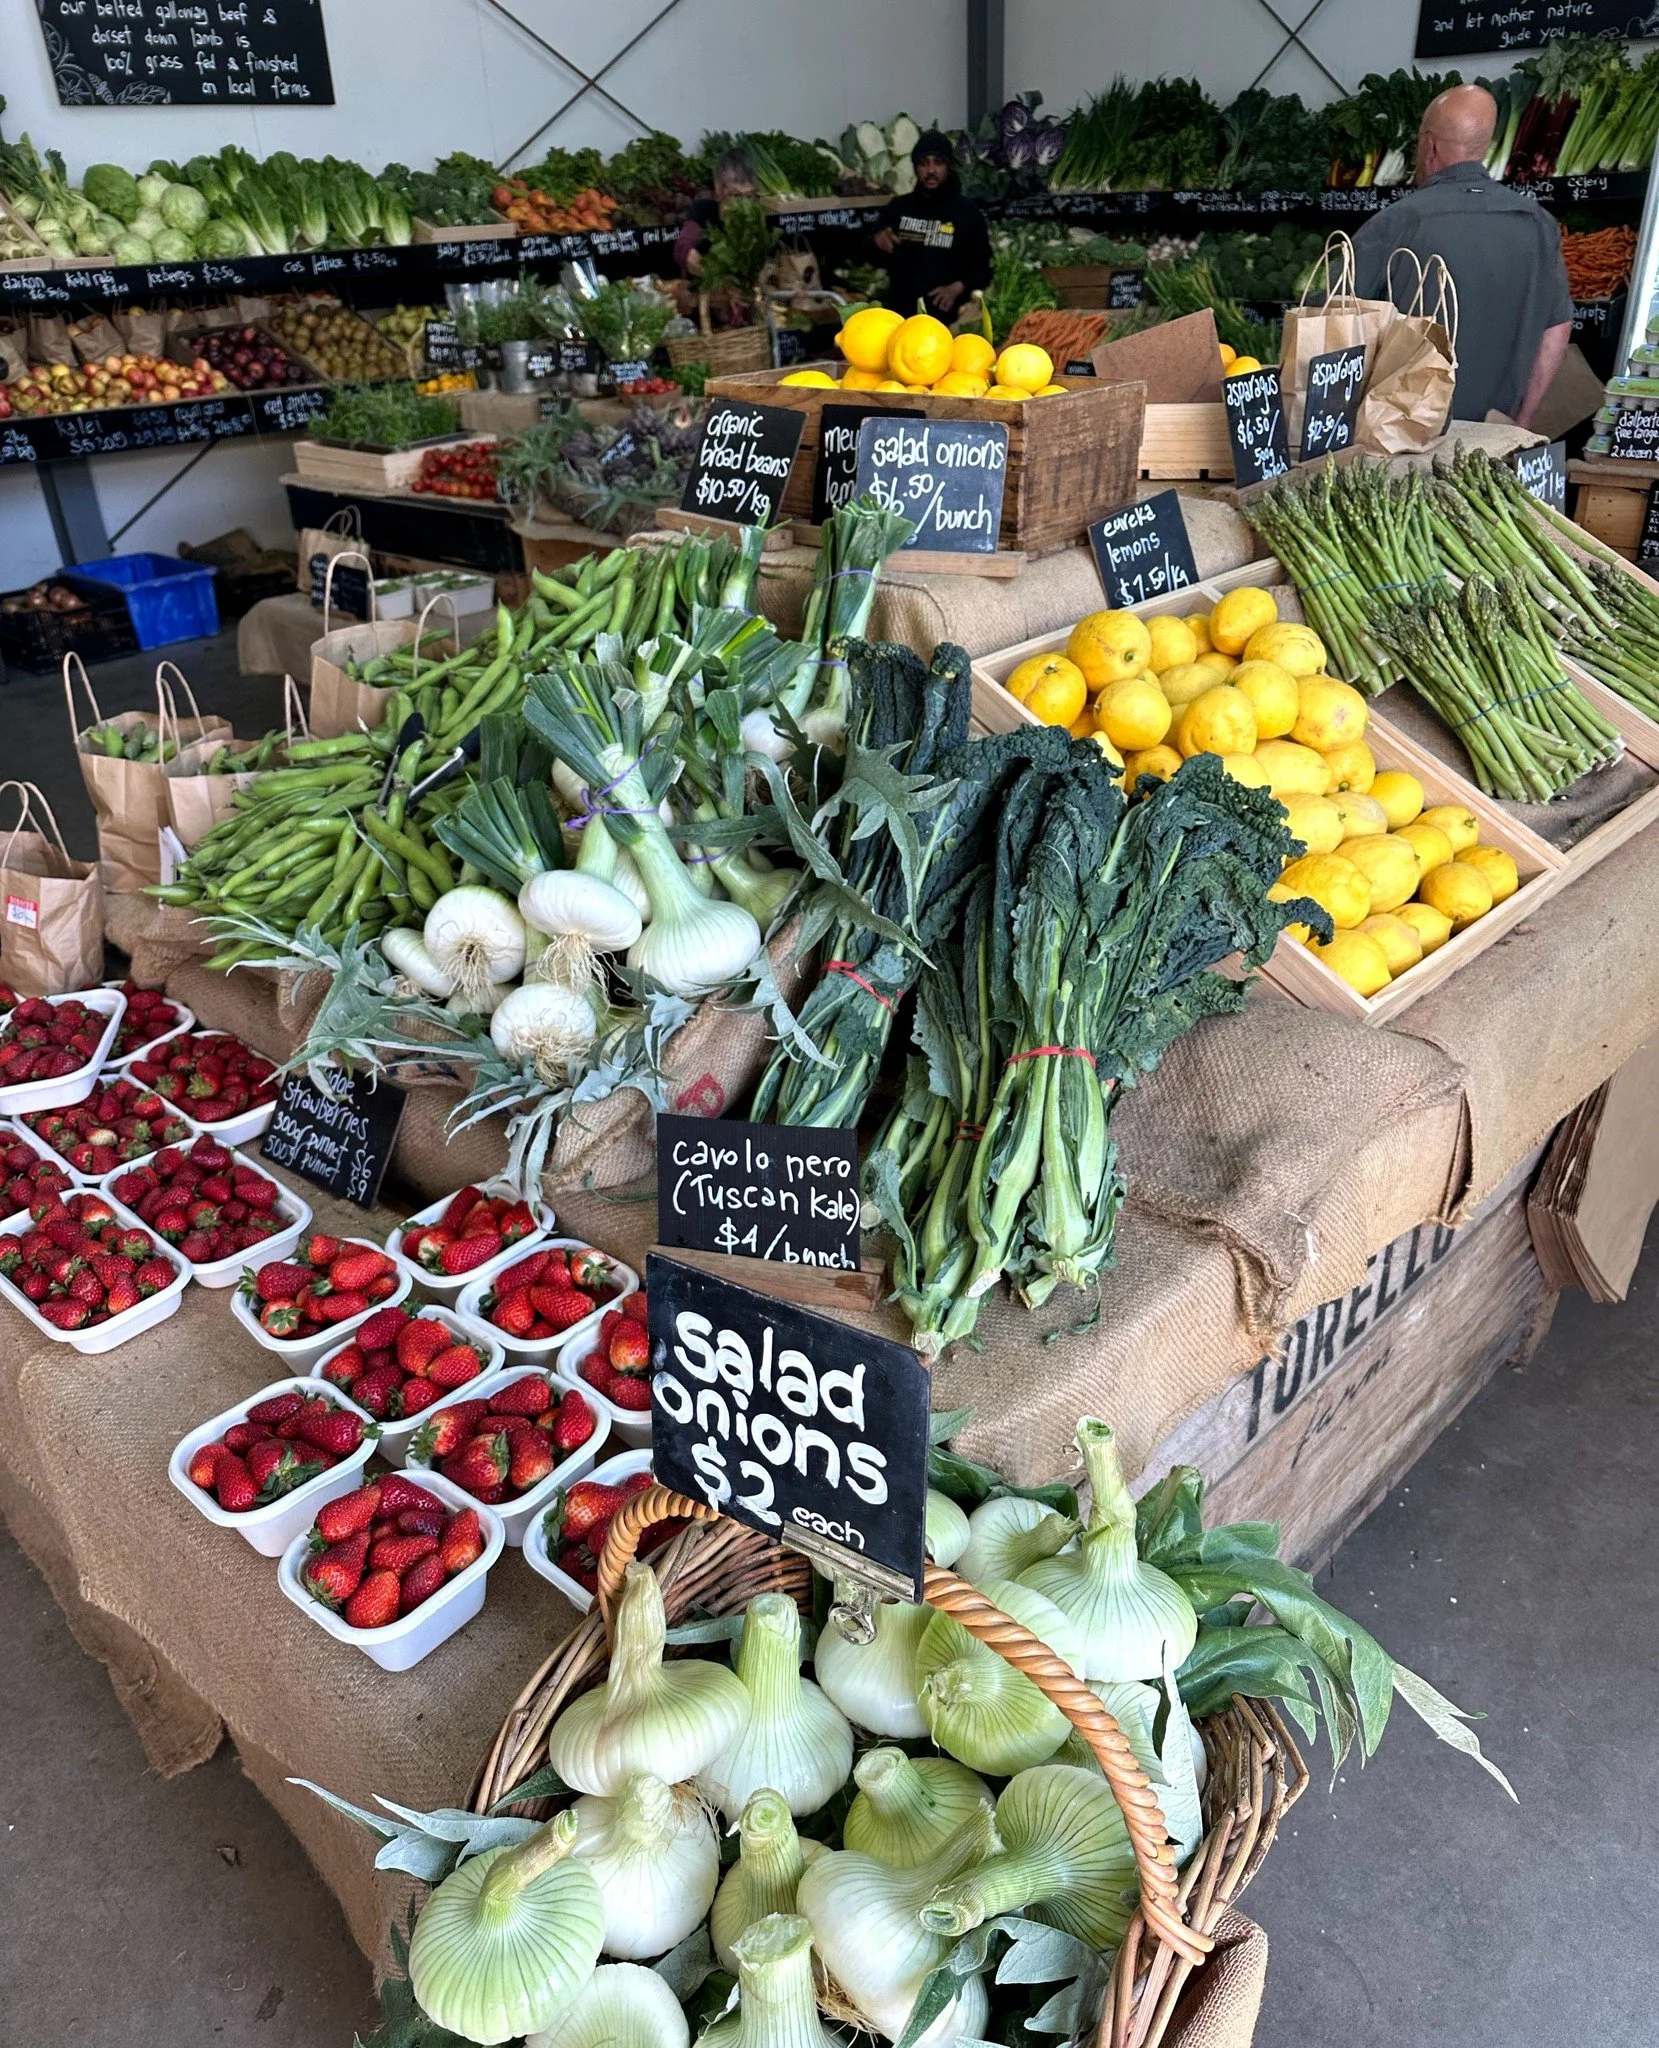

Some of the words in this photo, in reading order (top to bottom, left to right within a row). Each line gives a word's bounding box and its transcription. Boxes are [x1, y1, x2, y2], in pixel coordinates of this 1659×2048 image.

[60, 1, 85, 15] our
[95, 0, 143, 18] belted
[155, 2, 208, 27] galloway
[218, 0, 248, 25] beef
[1433, 19, 1453, 32] and
[1465, 12, 1483, 29] let
[1491, 8, 1536, 27] mother
[1547, 1, 1594, 19] nature
[92, 21, 131, 45] dorset
[144, 24, 178, 46] down
[191, 27, 224, 48] lamb
[236, 31, 250, 49] is
[1540, 26, 1566, 45] you
[146, 55, 184, 73] grass
[195, 52, 216, 75] fed
[246, 51, 298, 75] finished
[201, 81, 217, 95] on
[228, 75, 256, 97] local
[271, 76, 311, 99] farms
[1567, 177, 1608, 190] celery
[1572, 187, 1589, 200] $2
[283, 260, 305, 273] cos
[1574, 304, 1606, 326] arrots
[1311, 351, 1365, 401] asparagus
[1226, 372, 1279, 417] asparagus
[706, 409, 764, 449] organic
[700, 439, 743, 470] broad
[745, 441, 791, 478] beans
[825, 426, 859, 474] mey
[872, 427, 928, 469] salad
[935, 434, 1005, 470] onions
[825, 466, 855, 506] lem
[1103, 503, 1157, 538] eureka
[1106, 531, 1161, 573] lemons
[307, 1132, 349, 1161] punnet
[300, 1152, 341, 1185] punnet
[785, 1152, 851, 1183] nero
[671, 1170, 800, 1216] (Tuscan
[652, 1370, 889, 1506] onions
[692, 1435, 783, 1527] $2
[792, 1505, 866, 1551] each
